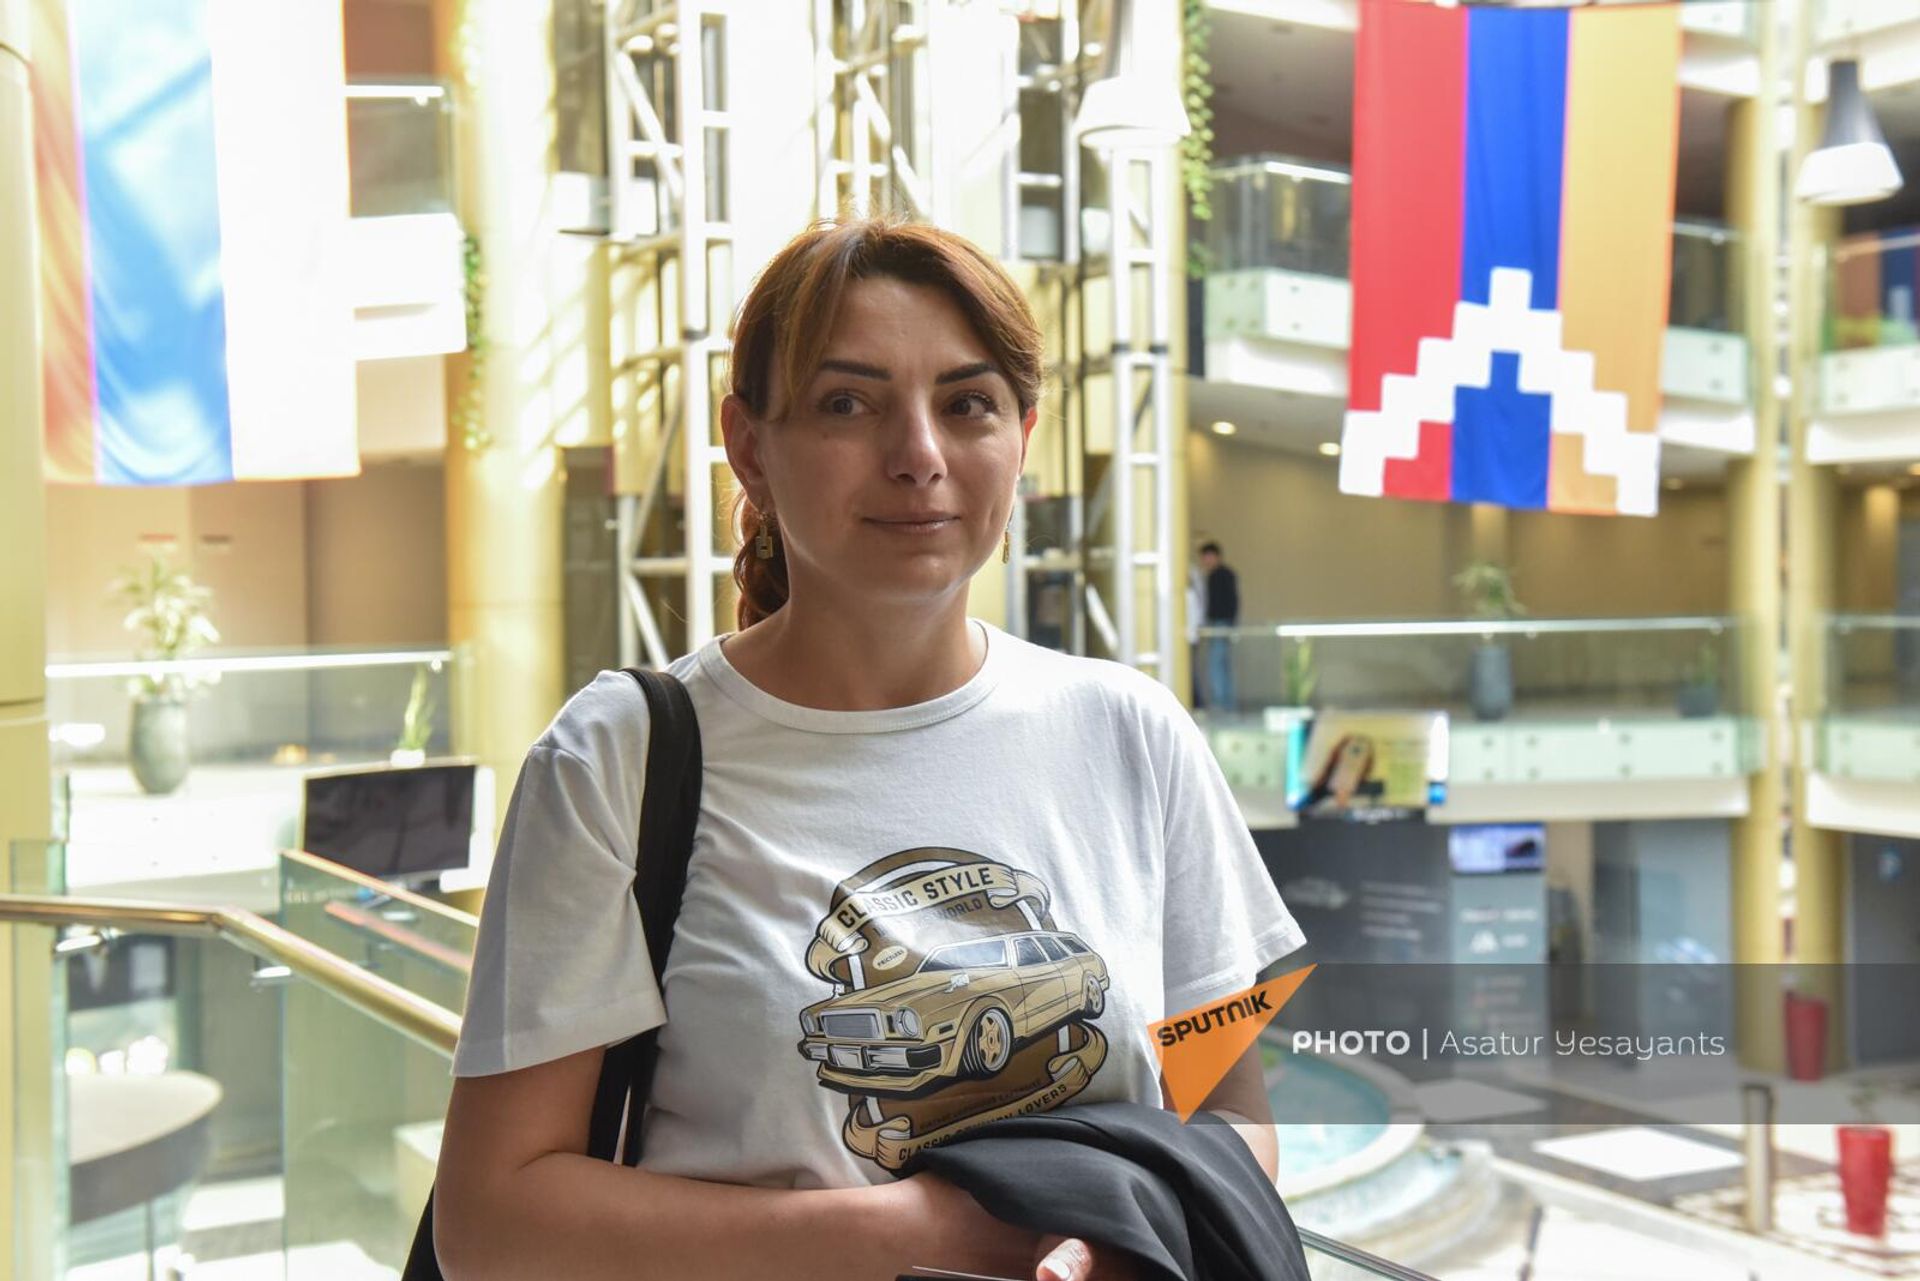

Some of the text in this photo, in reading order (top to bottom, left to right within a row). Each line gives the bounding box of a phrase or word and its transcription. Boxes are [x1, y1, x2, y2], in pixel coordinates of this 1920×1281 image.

[836, 867, 994, 929] CLASSIC STYLE
[1017, 1083, 1068, 1117] LOVERS
